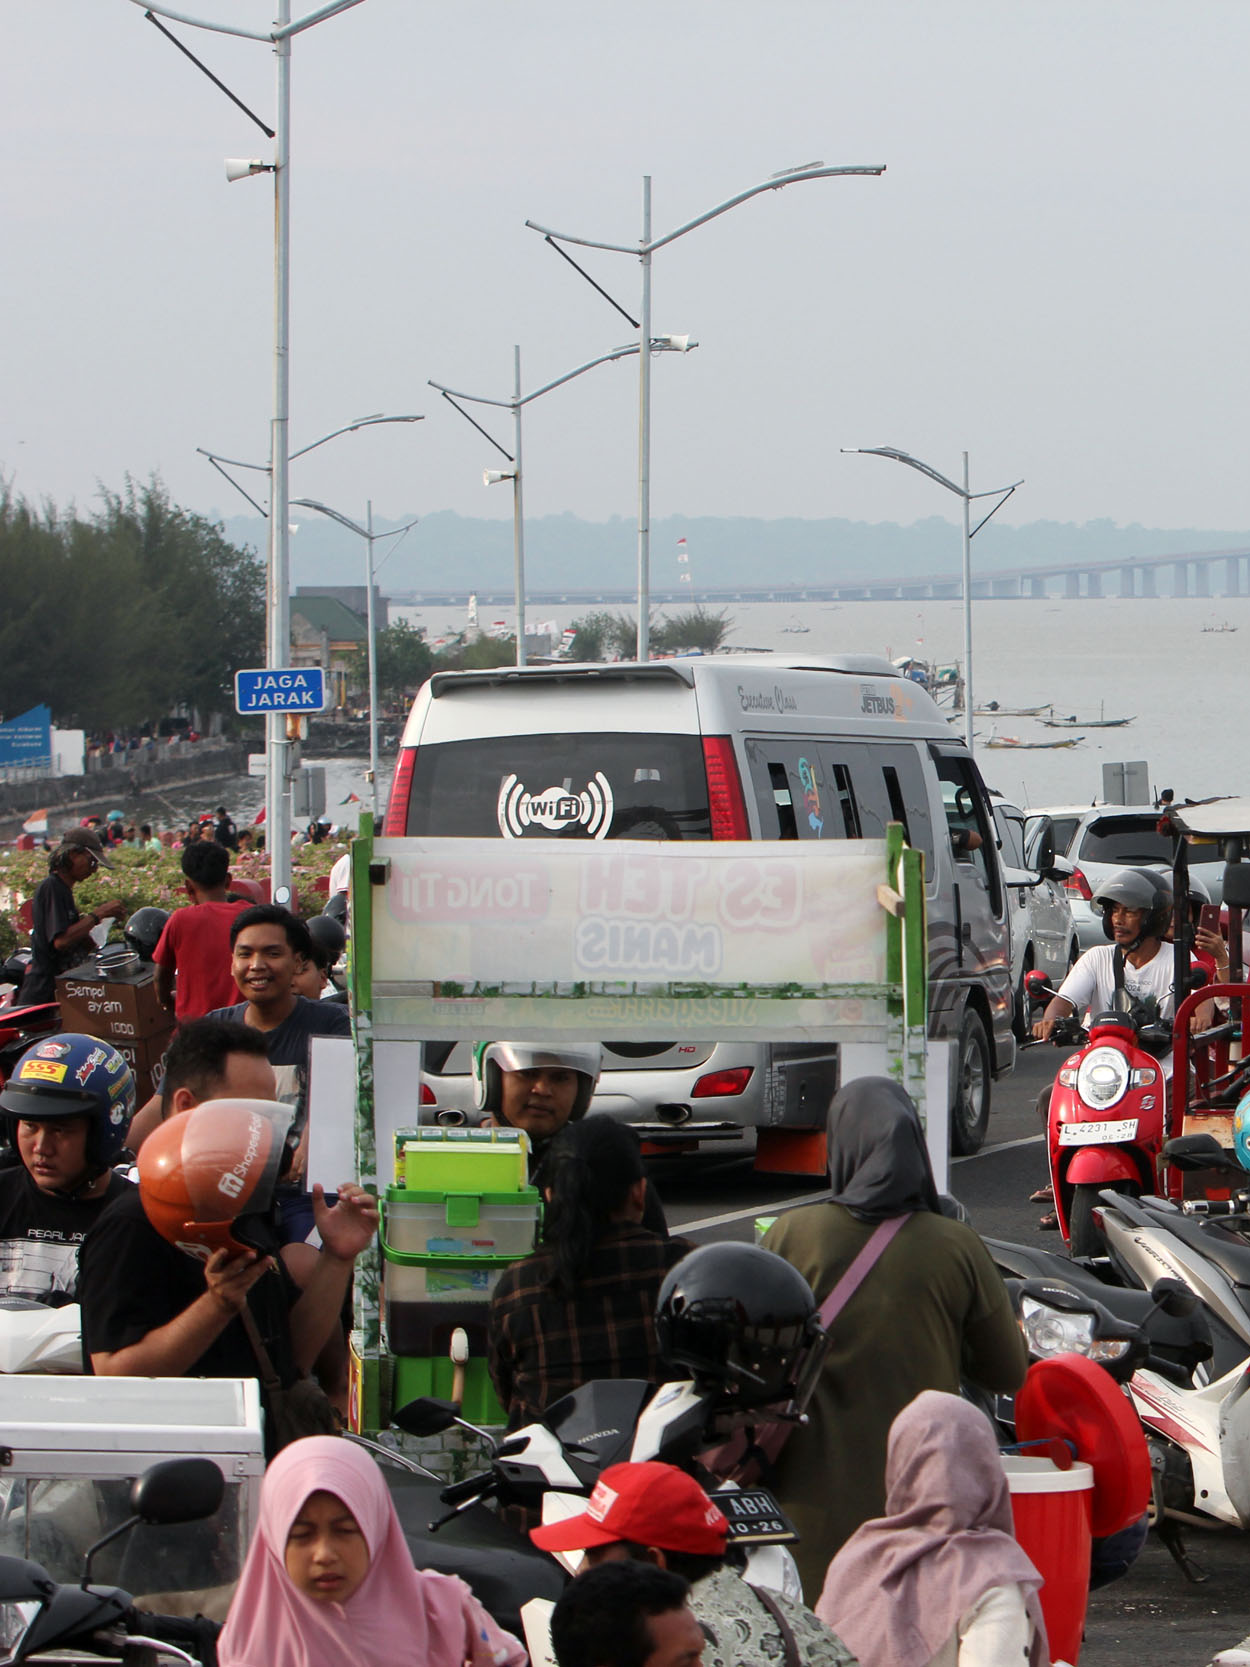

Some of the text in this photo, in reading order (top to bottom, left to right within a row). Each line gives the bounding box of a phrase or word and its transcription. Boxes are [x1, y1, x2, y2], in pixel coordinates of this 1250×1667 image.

[253, 675, 307, 689] JAGA
[247, 691, 314, 706] JARAK
[861, 696, 895, 714] JETBUS
[65, 982, 106, 999] Sempol
[88, 1001, 123, 1014] ayam
[110, 1022, 135, 1035] 1000
[1065, 1121, 1136, 1134] L 4231 SH
[28, 1229, 66, 1241] PEARL
[1042, 1287, 1080, 1300] HONDA
[578, 1428, 620, 1444] HONDA
[730, 1497, 773, 1515] ABH
